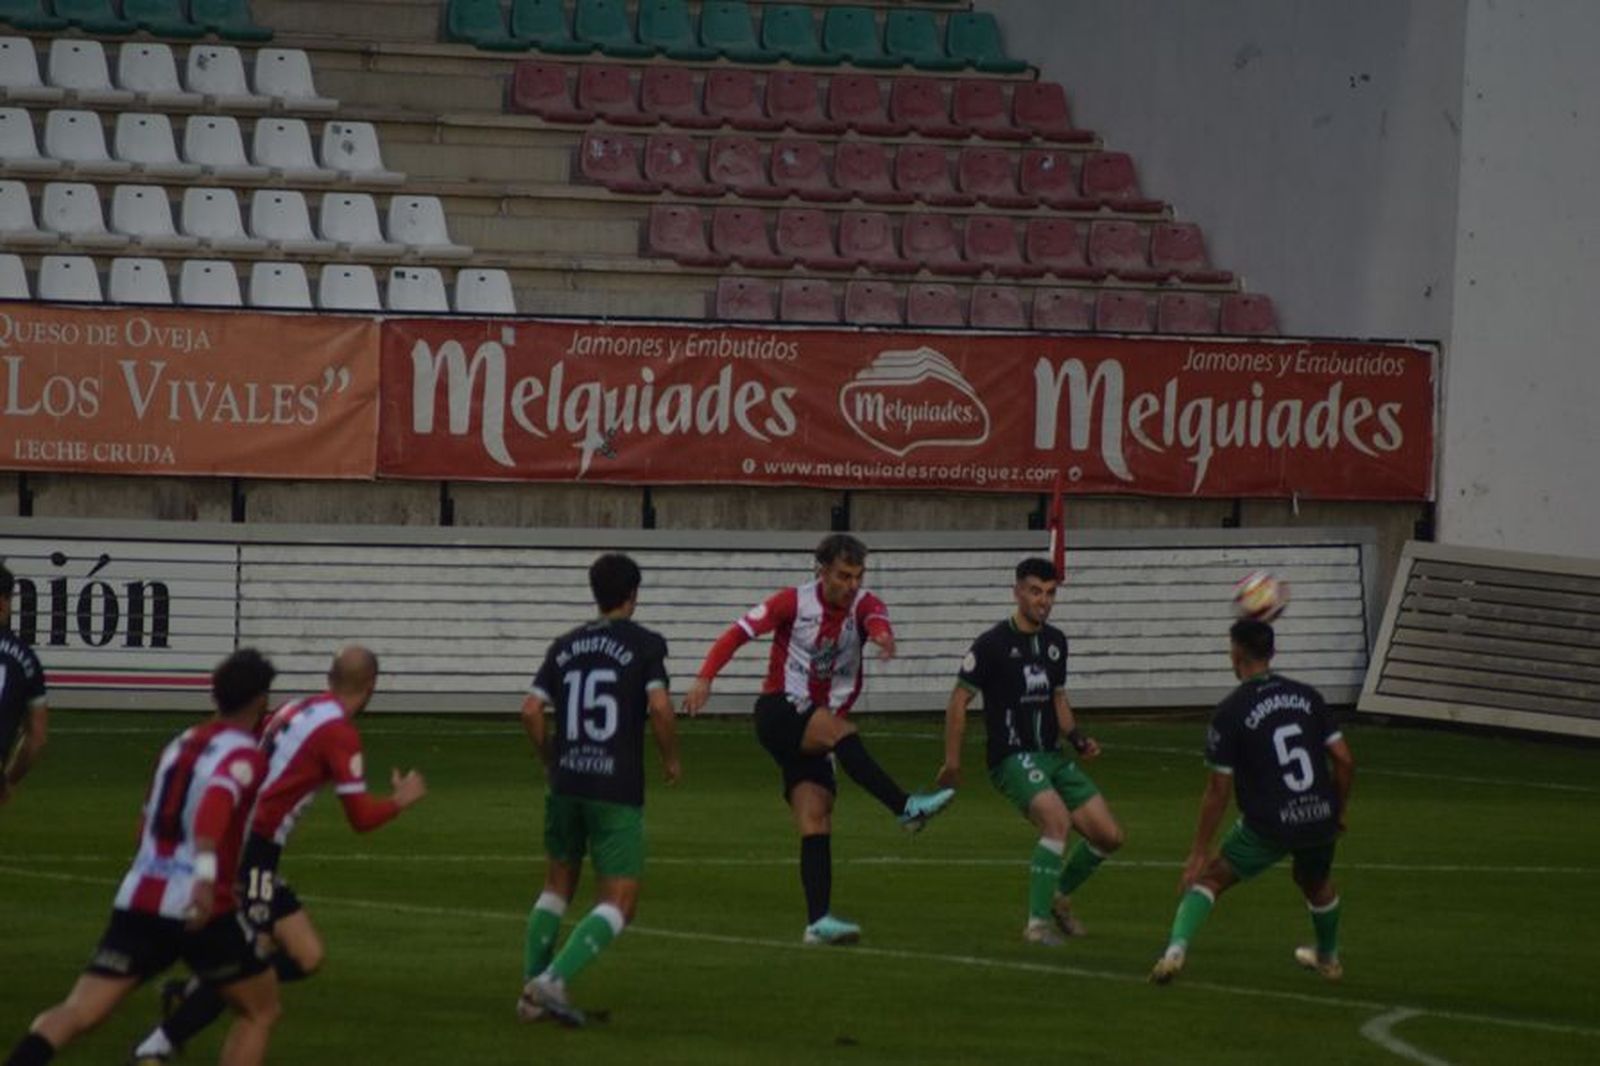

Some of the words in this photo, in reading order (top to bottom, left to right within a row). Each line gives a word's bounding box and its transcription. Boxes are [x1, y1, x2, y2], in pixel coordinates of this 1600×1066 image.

[87, 323, 118, 345] DE
[126, 317, 211, 353] OVEJA
[567, 330, 662, 357] Jamones
[667, 337, 678, 362] y
[685, 333, 798, 361] Embutidos
[1183, 347, 1273, 373] Jamones
[1277, 354, 1289, 377] y
[1296, 350, 1405, 377] Embutidos
[2, 355, 99, 418] LOS
[411, 338, 797, 480] Melquiades
[15, 440, 87, 462] LECHE
[94, 443, 176, 464] CRUDA
[1034, 356, 1403, 494] Melquiades
[563, 668, 618, 743] 15
[1273, 723, 1314, 792] 5
